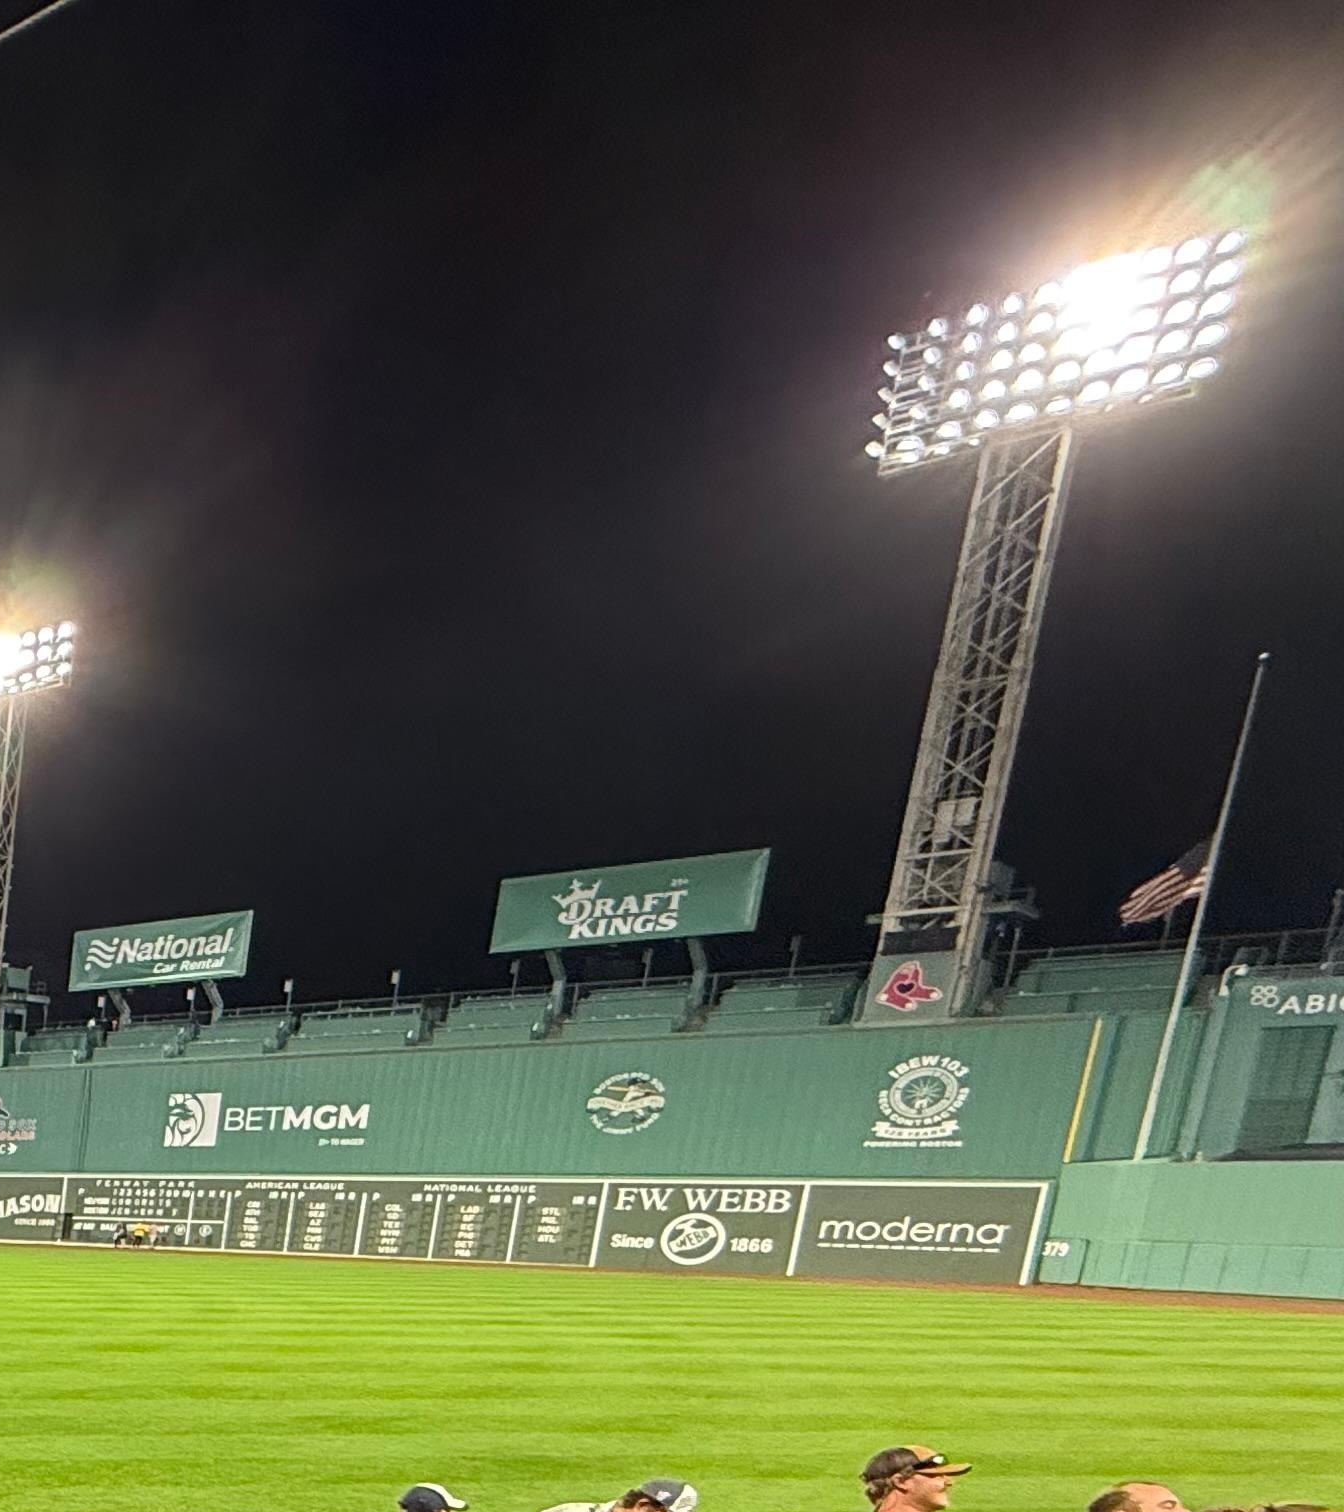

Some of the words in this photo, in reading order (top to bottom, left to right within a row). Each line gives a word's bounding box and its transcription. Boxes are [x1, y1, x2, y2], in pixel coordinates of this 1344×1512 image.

[558, 889, 688, 925] DRAFT
[568, 912, 679, 940] KINGS
[115, 928, 231, 965] National
[152, 961, 178, 974] Car
[180, 957, 224, 972] Rental
[1275, 994, 1344, 1014] ABI
[888, 1055, 941, 1079] IBEW
[940, 1056, 970, 1078] 103
[223, 1103, 371, 1132] BETMGM
[96, 1179, 150, 1188] FENWAY
[158, 1179, 195, 1188] PARK
[245, 1182, 299, 1190] AMERICAN
[302, 1182, 345, 1191] LEAGUE
[423, 1184, 482, 1193] NATIONAL
[487, 1184, 536, 1193] LEAGUE
[683, 1188, 792, 1213] WEBB
[674, 1229, 711, 1249] WEBB
[818, 1215, 1012, 1244] moderna
[610, 1233, 654, 1249] Since
[729, 1237, 774, 1253] 1866
[1042, 1241, 1070, 1257] 379
